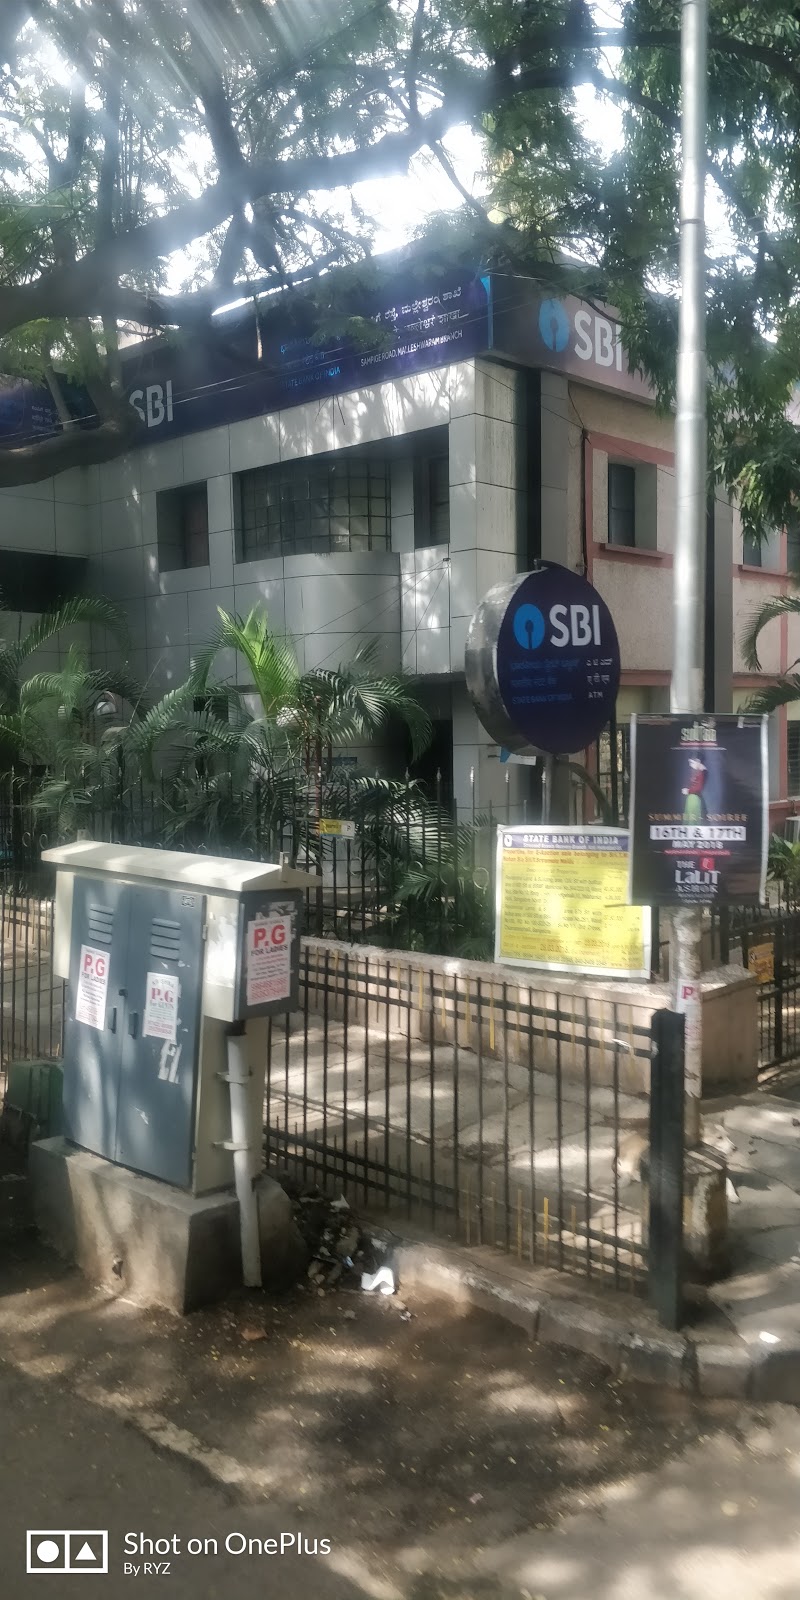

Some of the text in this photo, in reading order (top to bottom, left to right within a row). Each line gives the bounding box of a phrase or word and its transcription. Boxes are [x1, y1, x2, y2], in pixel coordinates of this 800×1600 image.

[574, 310, 622, 371] SBI
[360, 354, 381, 367] SAMPIGE
[129, 380, 174, 428] SBI
[549, 604, 602, 648] SBI
[588, 691, 603, 699] ATM
[648, 813, 697, 822] SUMMER
[706, 814, 748, 822] SOIREE
[522, 834, 619, 845] STATE BANK OF INDIA
[654, 827, 742, 840] 16TH & 17TH
[672, 841, 696, 849] MAY
[676, 861, 696, 869] THE
[675, 884, 719, 893] ASHOK
[254, 924, 285, 948] P.G
[250, 944, 288, 956] FOR LADIES
[84, 953, 105, 977] P.G
[81, 971, 106, 986] FOR LADIES
[151, 987, 174, 1003] P.G
